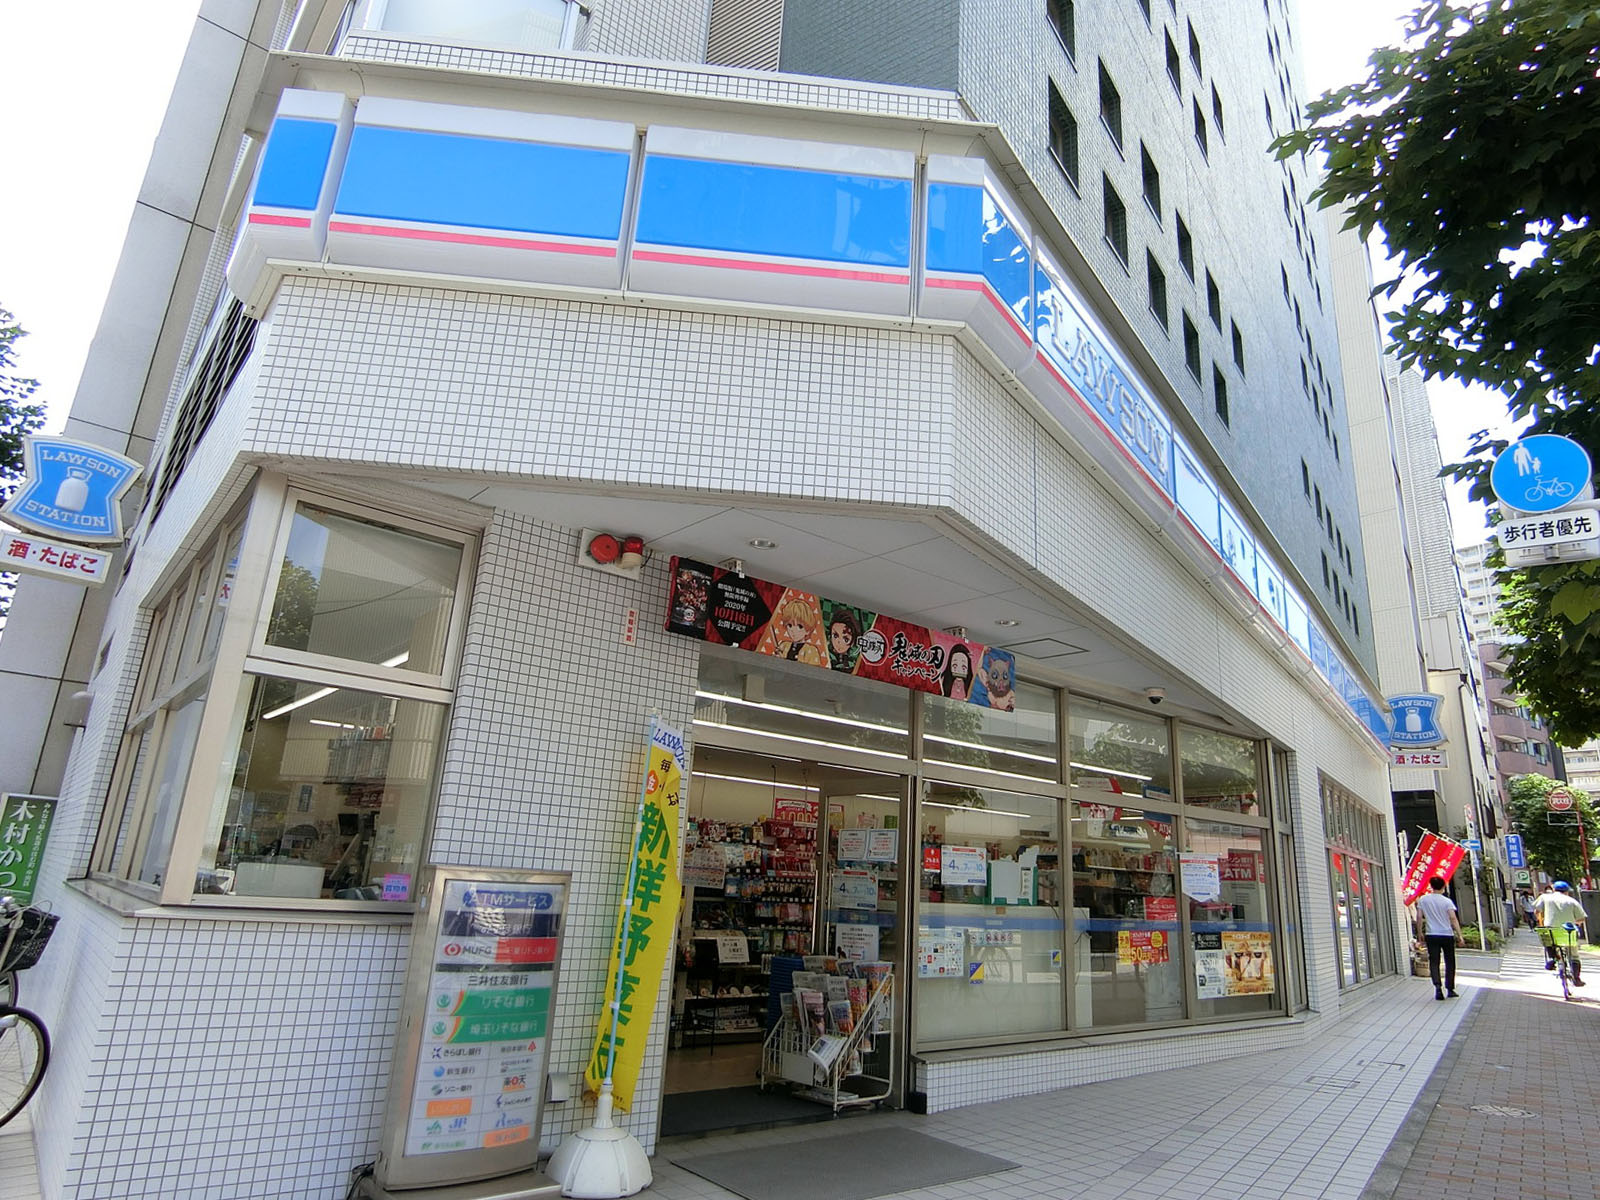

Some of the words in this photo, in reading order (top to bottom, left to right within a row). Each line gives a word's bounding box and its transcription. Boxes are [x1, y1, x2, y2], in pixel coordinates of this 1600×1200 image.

[1050, 294, 1169, 478] LAWSON
[42, 449, 122, 479] LAWSON
[24, 499, 106, 528] STATION
[1504, 516, 1592, 543] 歩行者優先
[7, 539, 98, 574] 酒・たばこ
[724, 600, 747, 611] 2020年
[714, 606, 755, 627] 10月16日
[888, 633, 945, 669] 鬼滅の刃
[891, 659, 941, 681] キャンペーン
[1391, 699, 1433, 709] LAWSON
[1394, 731, 1436, 740] STATION
[1395, 755, 1441, 765] 酒・たばこ
[0, 800, 37, 888] 木村かつ
[1223, 868, 1252, 879] ATM
[469, 892, 548, 908] ATMサービス
[462, 945, 492, 955] MUFG
[468, 975, 529, 986] 三井住友銀行
[481, 994, 534, 1008] りそな銀行
[469, 1021, 538, 1035] 埼玉りそな銀行
[443, 1047, 482, 1058] きらぼし銀行
[446, 1066, 475, 1076] 新生銀行
[444, 1084, 473, 1093] ソニー銀行
